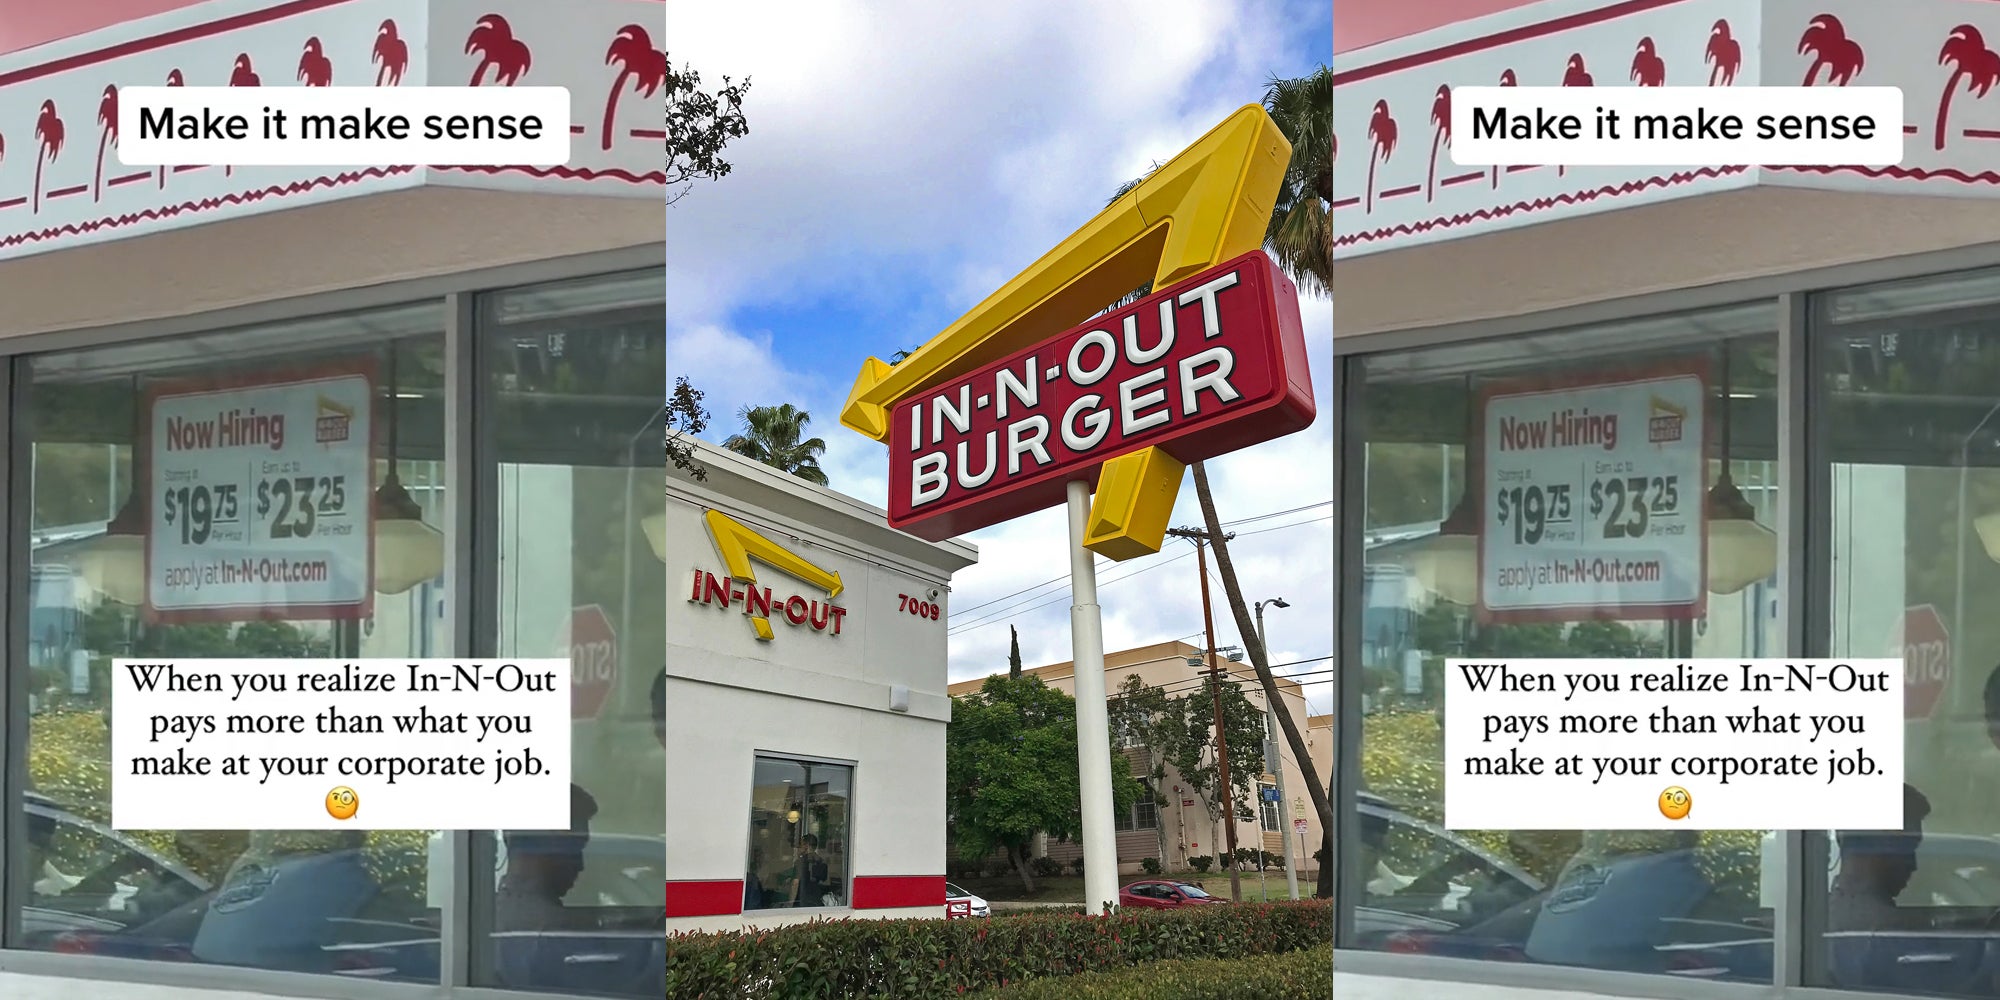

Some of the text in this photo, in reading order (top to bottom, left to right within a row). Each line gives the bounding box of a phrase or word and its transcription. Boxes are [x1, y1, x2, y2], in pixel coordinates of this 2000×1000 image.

[911, 271, 1239, 451] IN-N-OUT
[166, 408, 285, 450] Now Hiring
[911, 346, 1242, 508] BURGER
[1499, 408, 1618, 450] Now Hiring
[165, 558, 327, 590] apply at In-N-Out.com
[1498, 558, 1660, 590] apply at In-N-Out.com
[689, 569, 847, 635] IN-N-OUT
[898, 593, 940, 621] 7009
